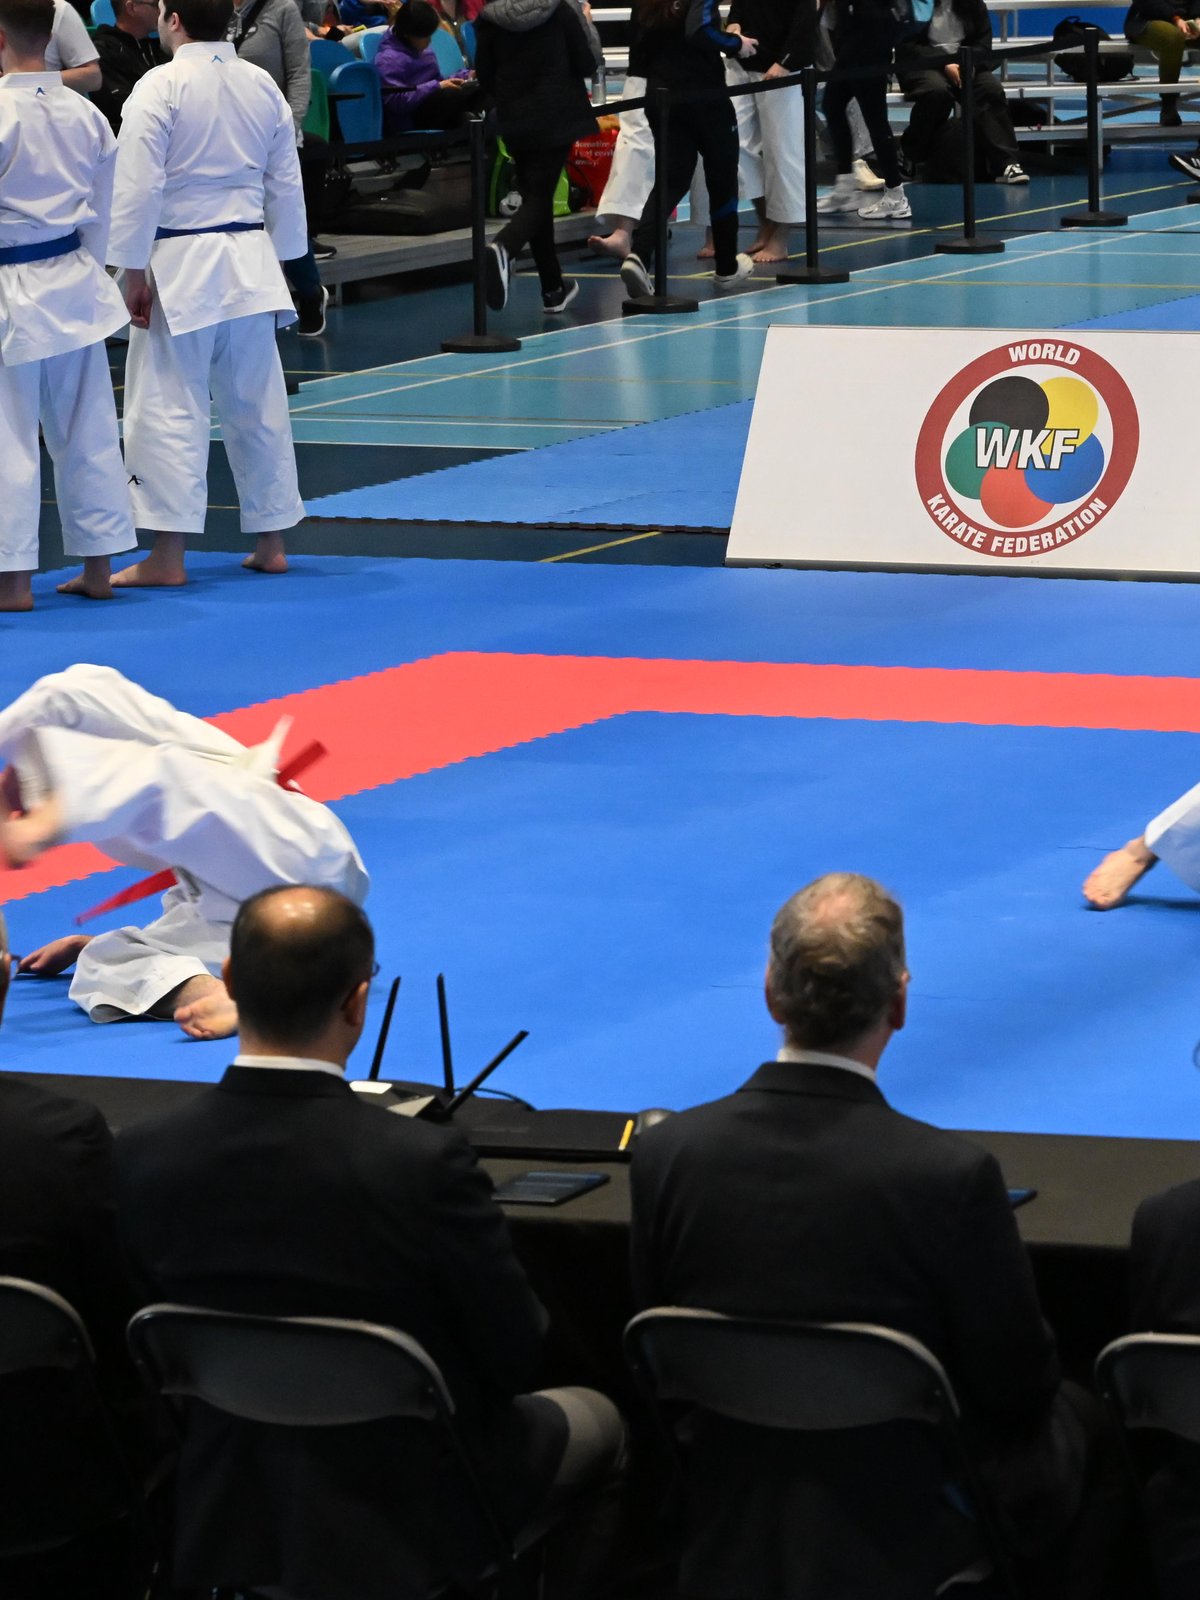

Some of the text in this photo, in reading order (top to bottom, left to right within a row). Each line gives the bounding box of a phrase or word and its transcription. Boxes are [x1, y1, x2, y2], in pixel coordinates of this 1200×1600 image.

[1008, 343, 1081, 366] WORLD
[975, 427, 1080, 470] WKF
[926, 492, 1108, 554] KARATE FEDERATION
